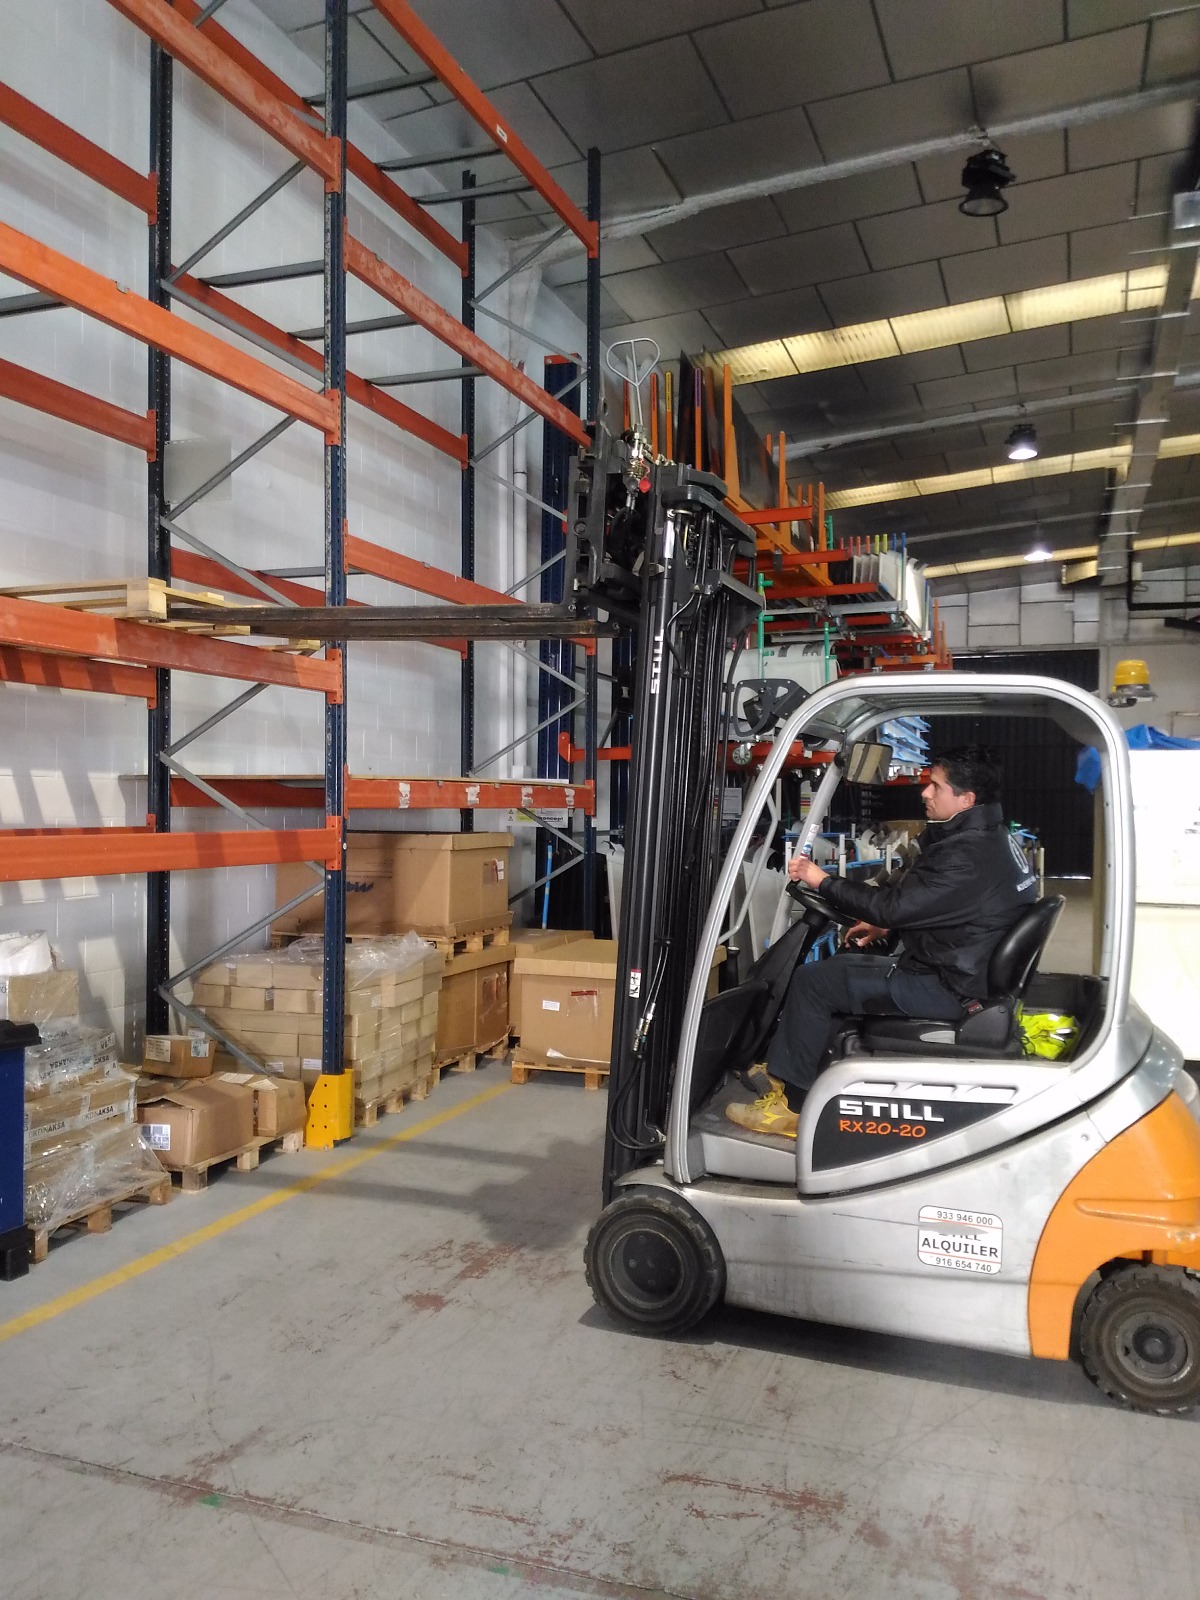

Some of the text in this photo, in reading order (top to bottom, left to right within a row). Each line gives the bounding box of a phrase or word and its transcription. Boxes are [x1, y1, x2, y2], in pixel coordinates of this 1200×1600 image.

[650, 629, 664, 694] STILL
[839, 1099, 945, 1123] STILL
[839, 1119, 927, 1138] RX20-20
[937, 1210, 993, 1226] 933 946 000
[921, 1237, 999, 1259] ALQUILER
[936, 1257, 992, 1272] 916 654 740
